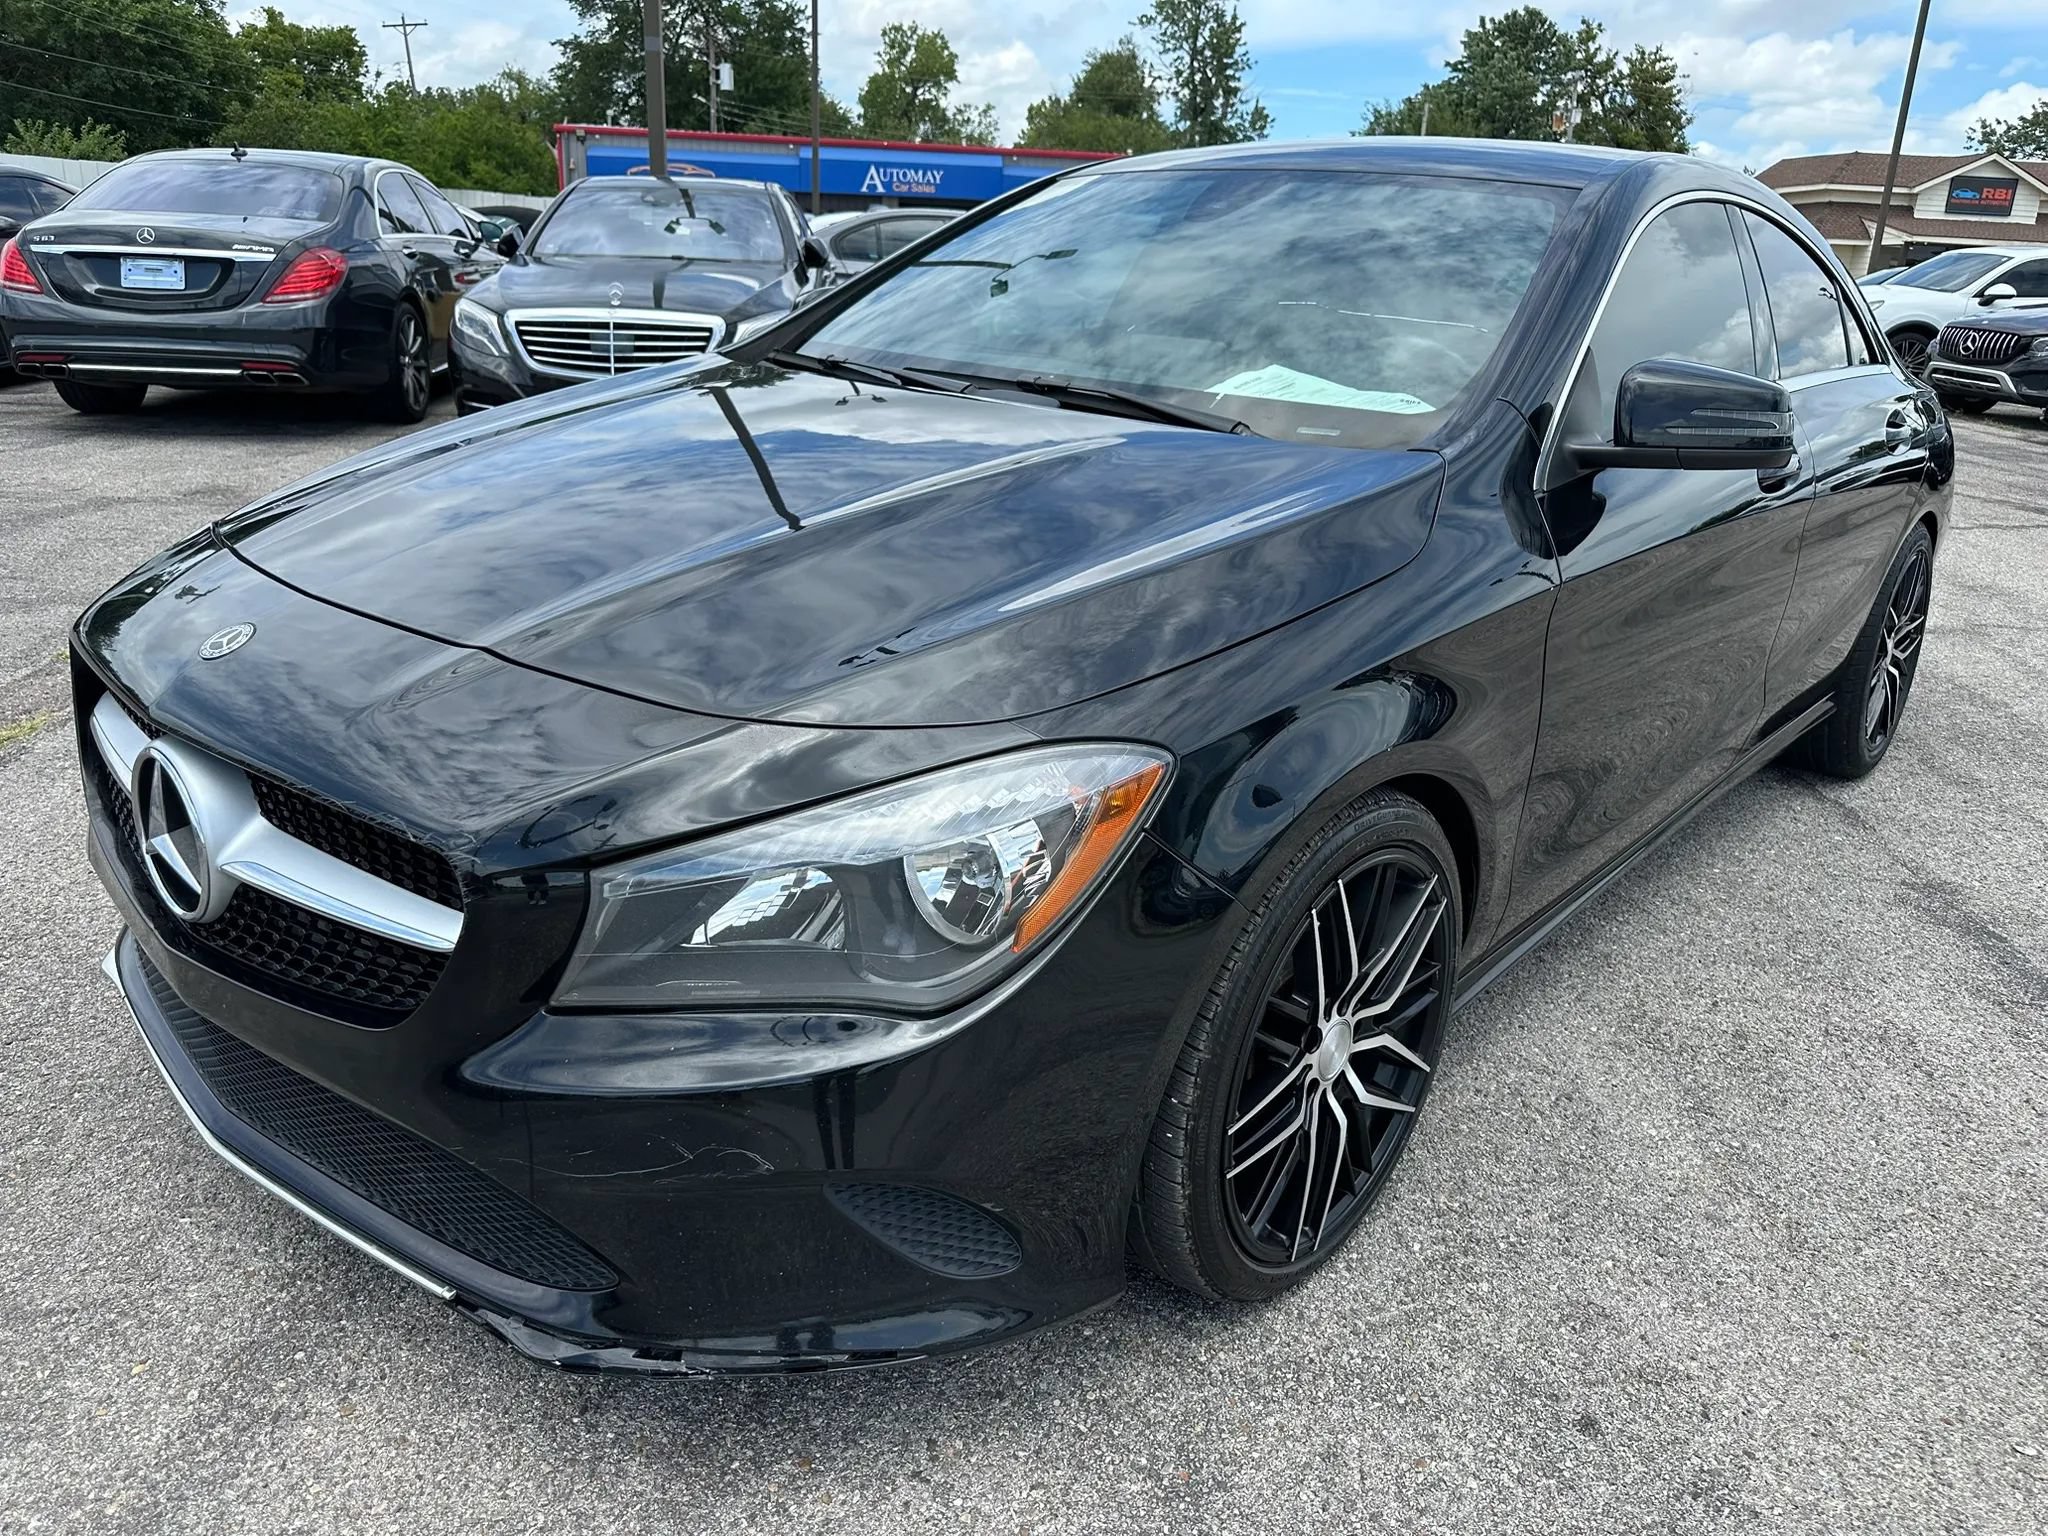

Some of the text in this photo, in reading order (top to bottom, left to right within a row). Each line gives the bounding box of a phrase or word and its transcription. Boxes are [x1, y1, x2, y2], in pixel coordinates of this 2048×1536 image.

[860, 163, 944, 193] AUTOMAY
[892, 182, 936, 194] Car Sales
[1981, 187, 2013, 200] RBI
